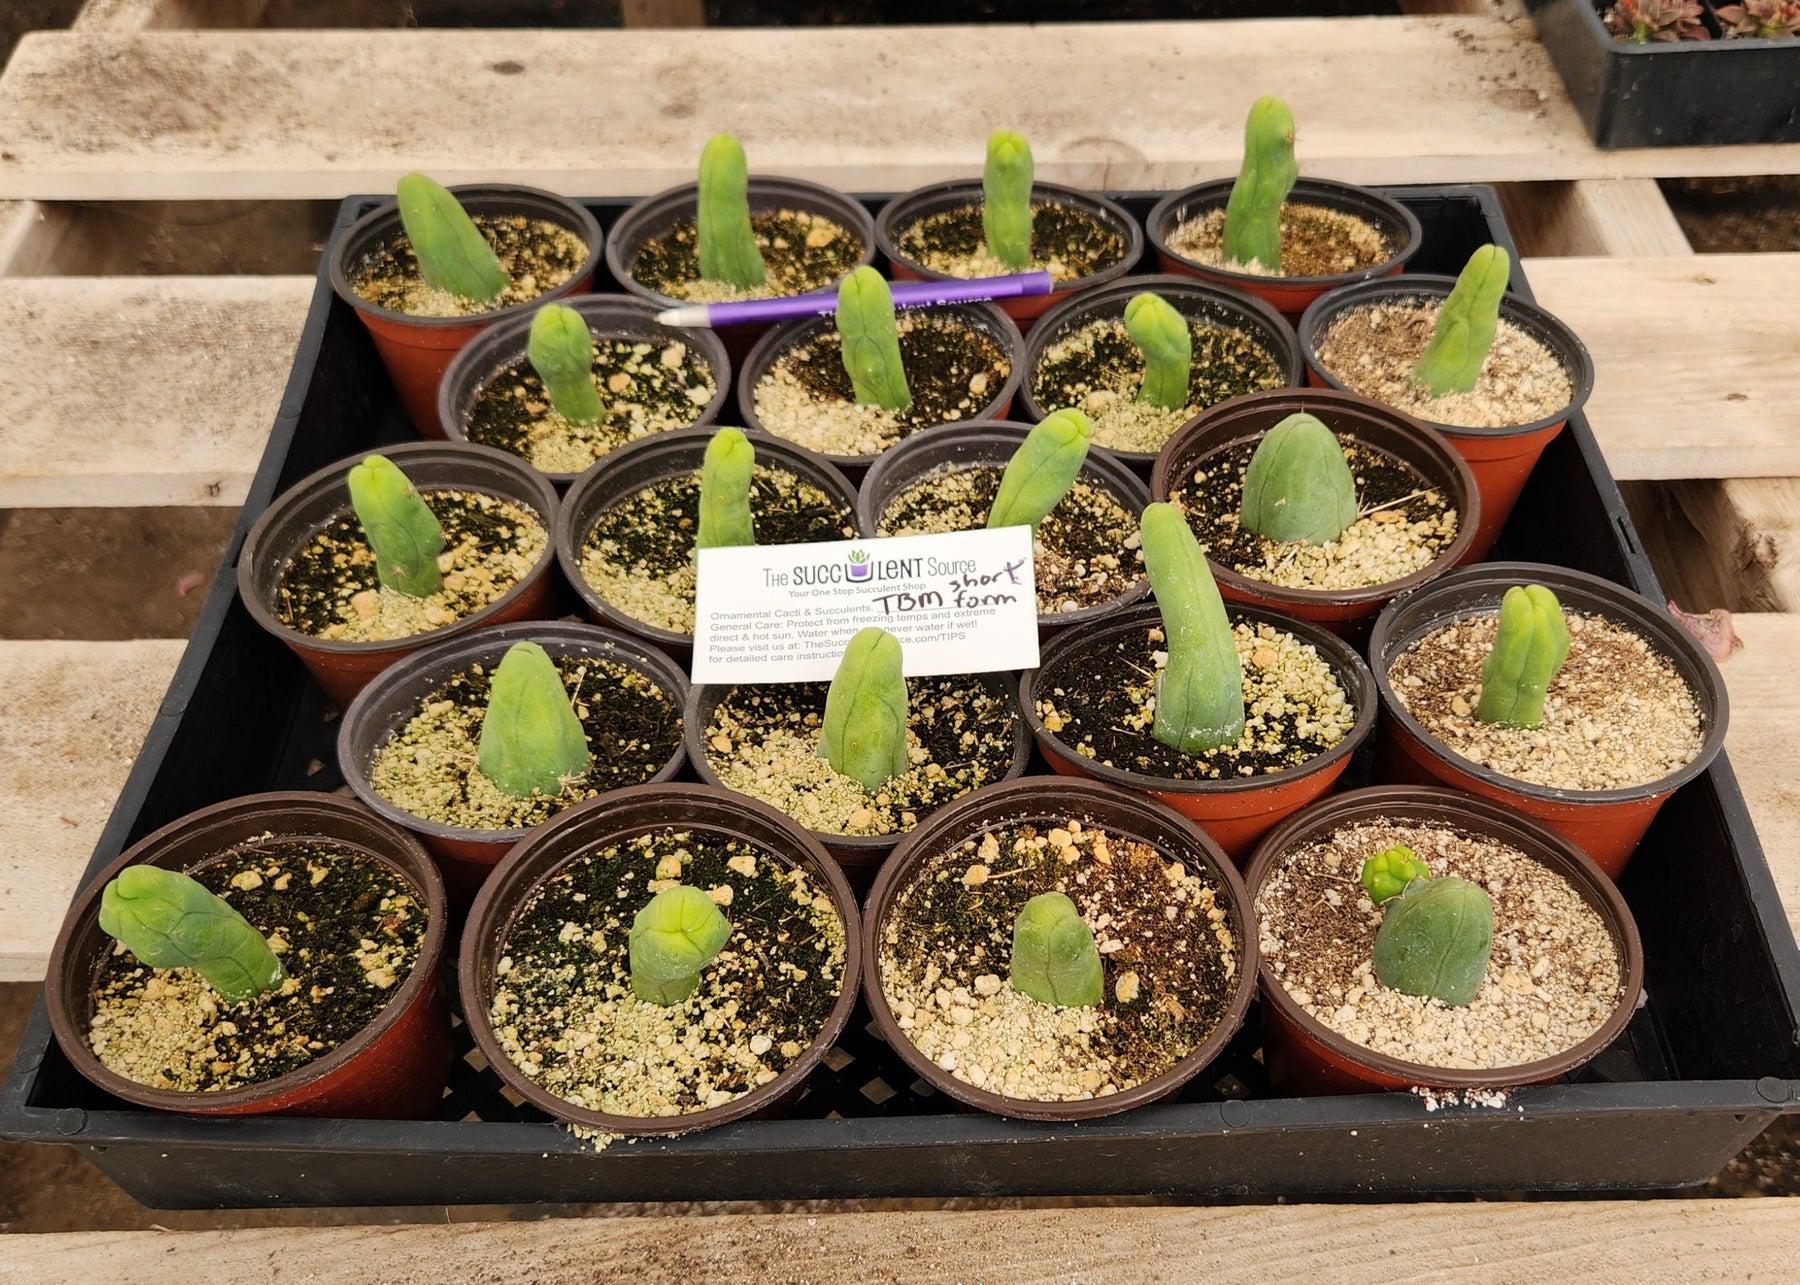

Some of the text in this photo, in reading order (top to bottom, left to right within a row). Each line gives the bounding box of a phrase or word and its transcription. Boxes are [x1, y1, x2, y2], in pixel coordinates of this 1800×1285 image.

[927, 557, 976, 577] Source
[949, 557, 1027, 593] short
[789, 582, 927, 598] Your One Stop Succulent Shop
[954, 590, 1017, 609] form
[710, 604, 874, 621] Ornamental Cacti & Succulents.
[710, 607, 996, 632] General Care: Protect from freezing temps and extreme
[709, 617, 978, 643] direct & hot sun. Water when never water if wet!
[708, 643, 746, 653] Please
[748, 641, 770, 652] visit
[772, 643, 785, 651] us
[787, 640, 801, 650] at:
[709, 648, 844, 664] for detailed care instructio
